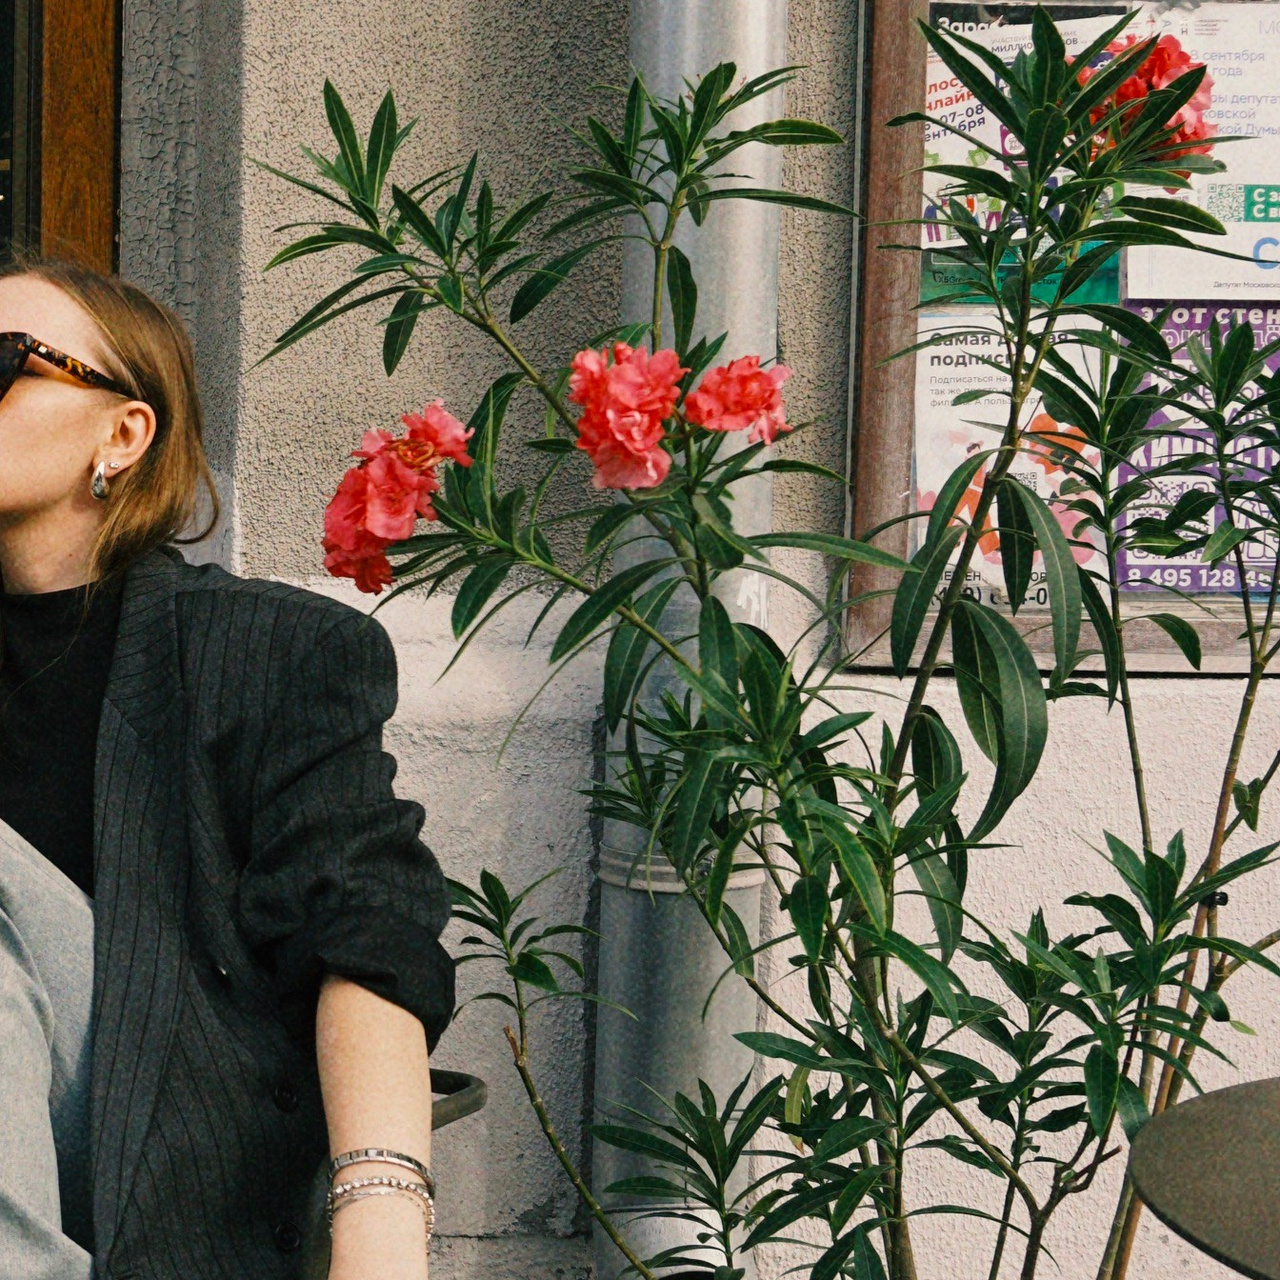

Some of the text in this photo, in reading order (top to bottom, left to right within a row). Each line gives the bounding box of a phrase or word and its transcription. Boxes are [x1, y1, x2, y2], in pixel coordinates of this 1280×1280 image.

[1202, 50, 1266, 63] сентября
[1212, 66, 1243, 77] года
[1141, 306, 1208, 324] эот
[930, 353, 1026, 368] подпис
[930, 376, 994, 385] Подписаться
[930, 388, 945, 396] так
[948, 388, 961, 396] же
[1128, 569, 1141, 587] 8
[1148, 569, 1192, 588] 495
[1199, 569, 1236, 587] 128
